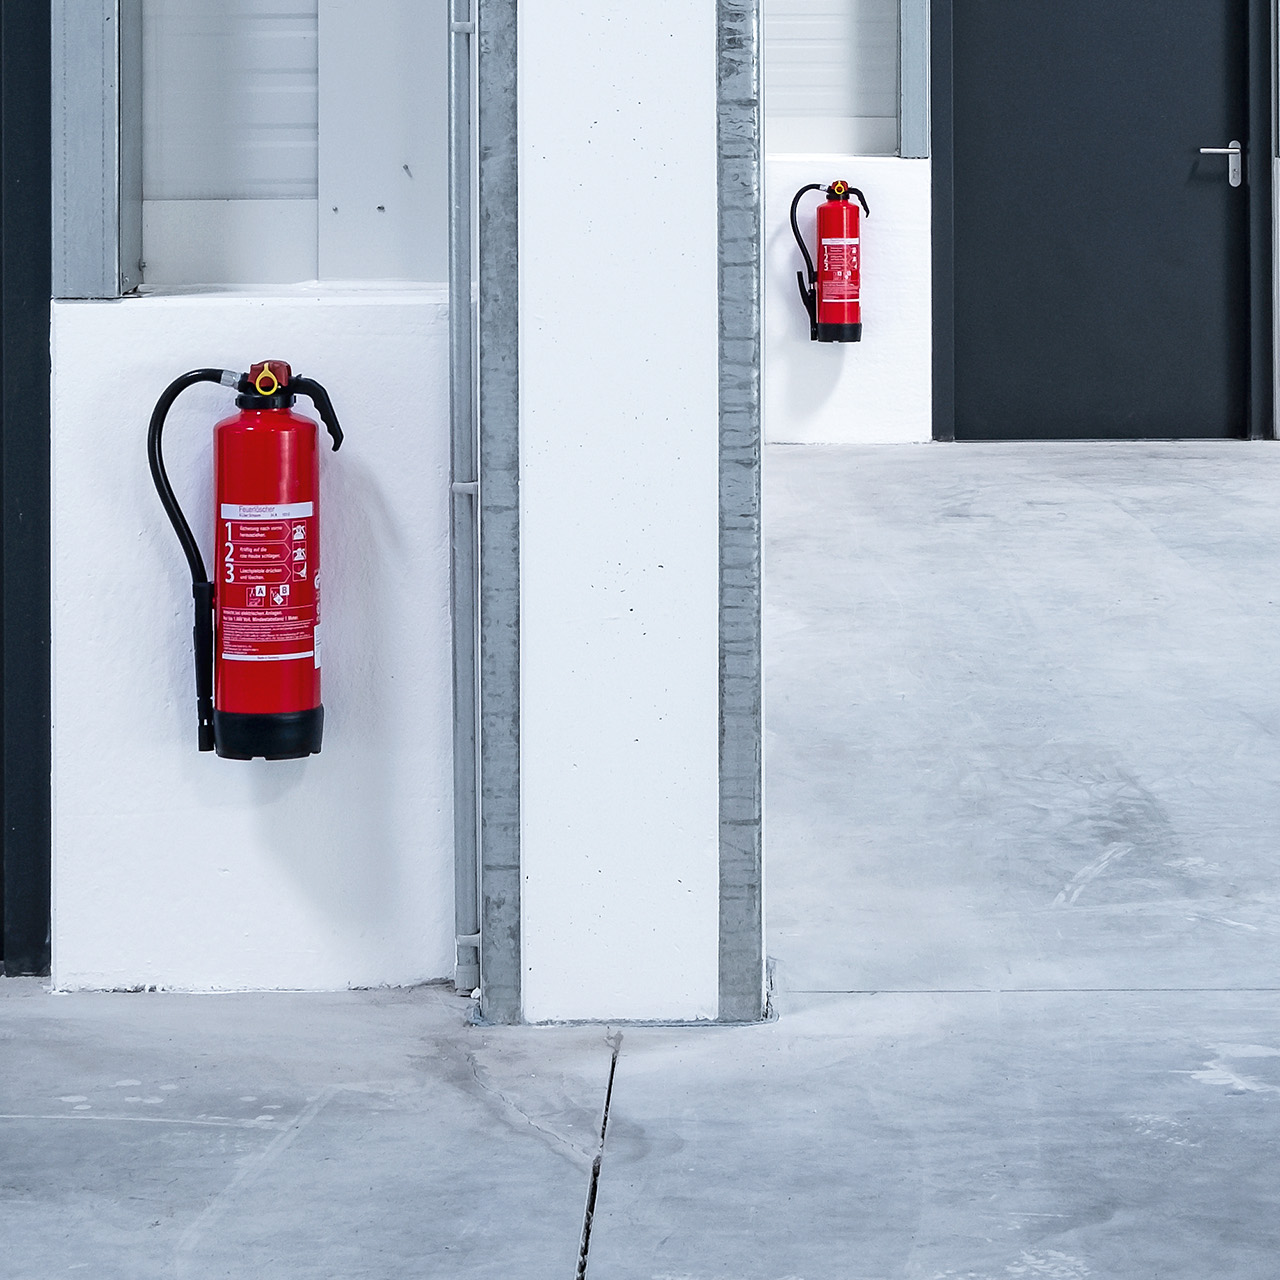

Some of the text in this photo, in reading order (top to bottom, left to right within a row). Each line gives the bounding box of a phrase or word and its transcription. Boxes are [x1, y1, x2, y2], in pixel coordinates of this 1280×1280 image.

[225, 522, 232, 541] 1
[225, 542, 234, 562] 2
[225, 563, 235, 583] 3
[258, 587, 264, 595] A
[282, 586, 287, 594] B
